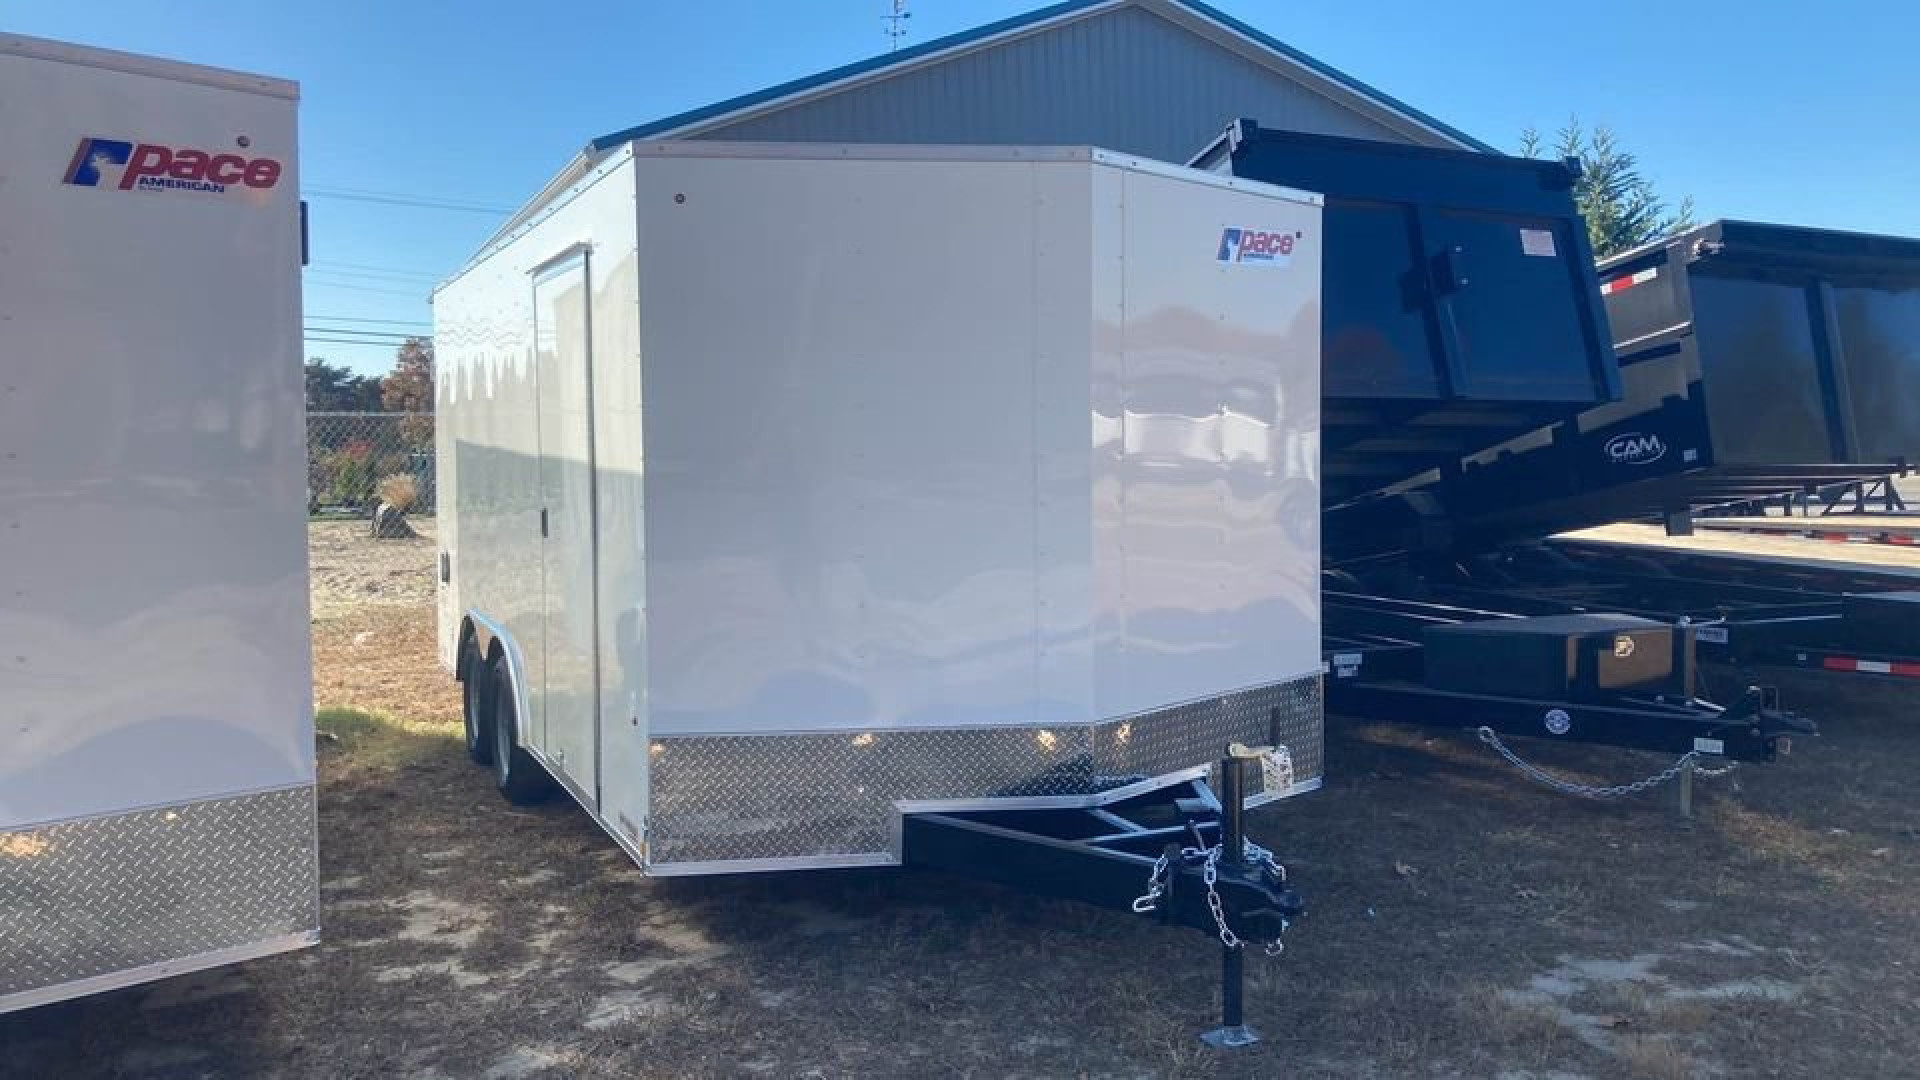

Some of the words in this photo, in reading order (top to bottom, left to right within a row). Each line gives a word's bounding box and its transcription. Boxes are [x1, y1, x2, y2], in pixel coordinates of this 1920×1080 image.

[118, 143, 282, 190] pace
[139, 177, 225, 193] AMERICAN
[1236, 230, 1294, 262] pace
[1610, 436, 1660, 457] CAM
